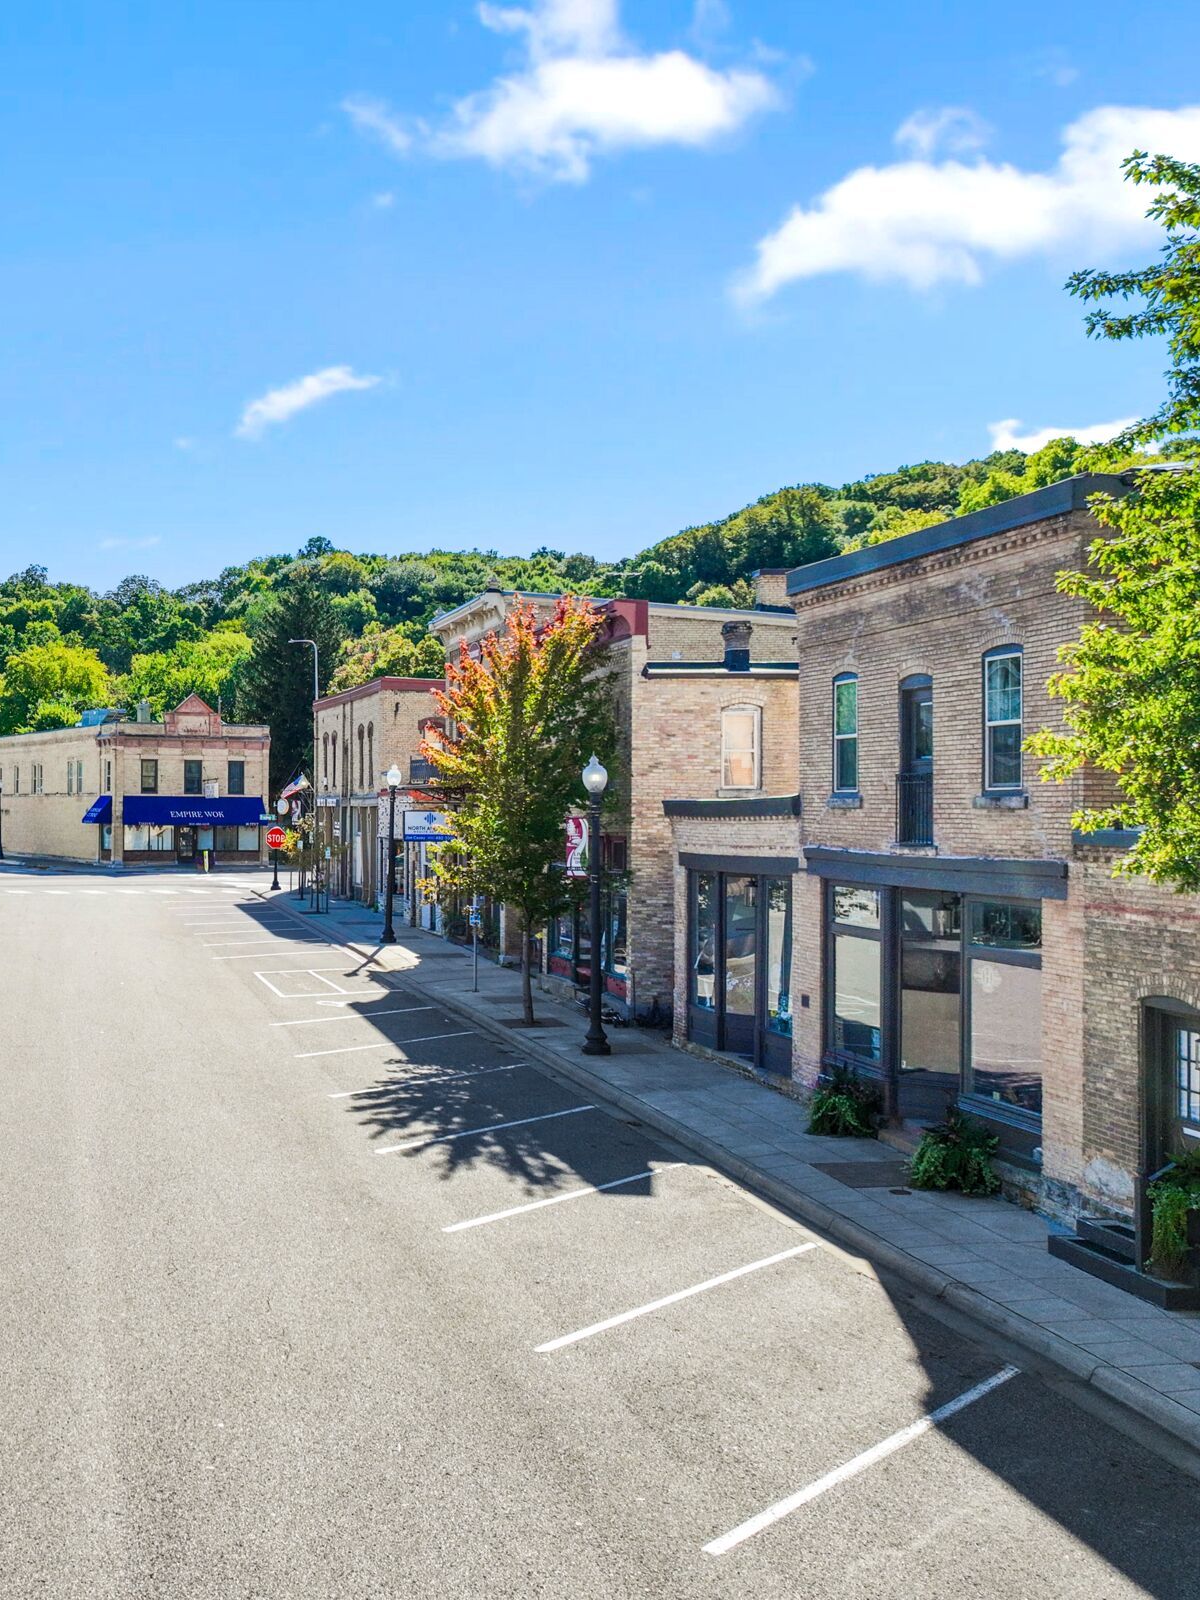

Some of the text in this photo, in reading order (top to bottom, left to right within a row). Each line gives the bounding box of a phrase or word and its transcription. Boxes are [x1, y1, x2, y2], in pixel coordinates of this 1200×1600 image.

[170, 810, 225, 818] EMPIRE WOK
[267, 834, 286, 843] STOP
